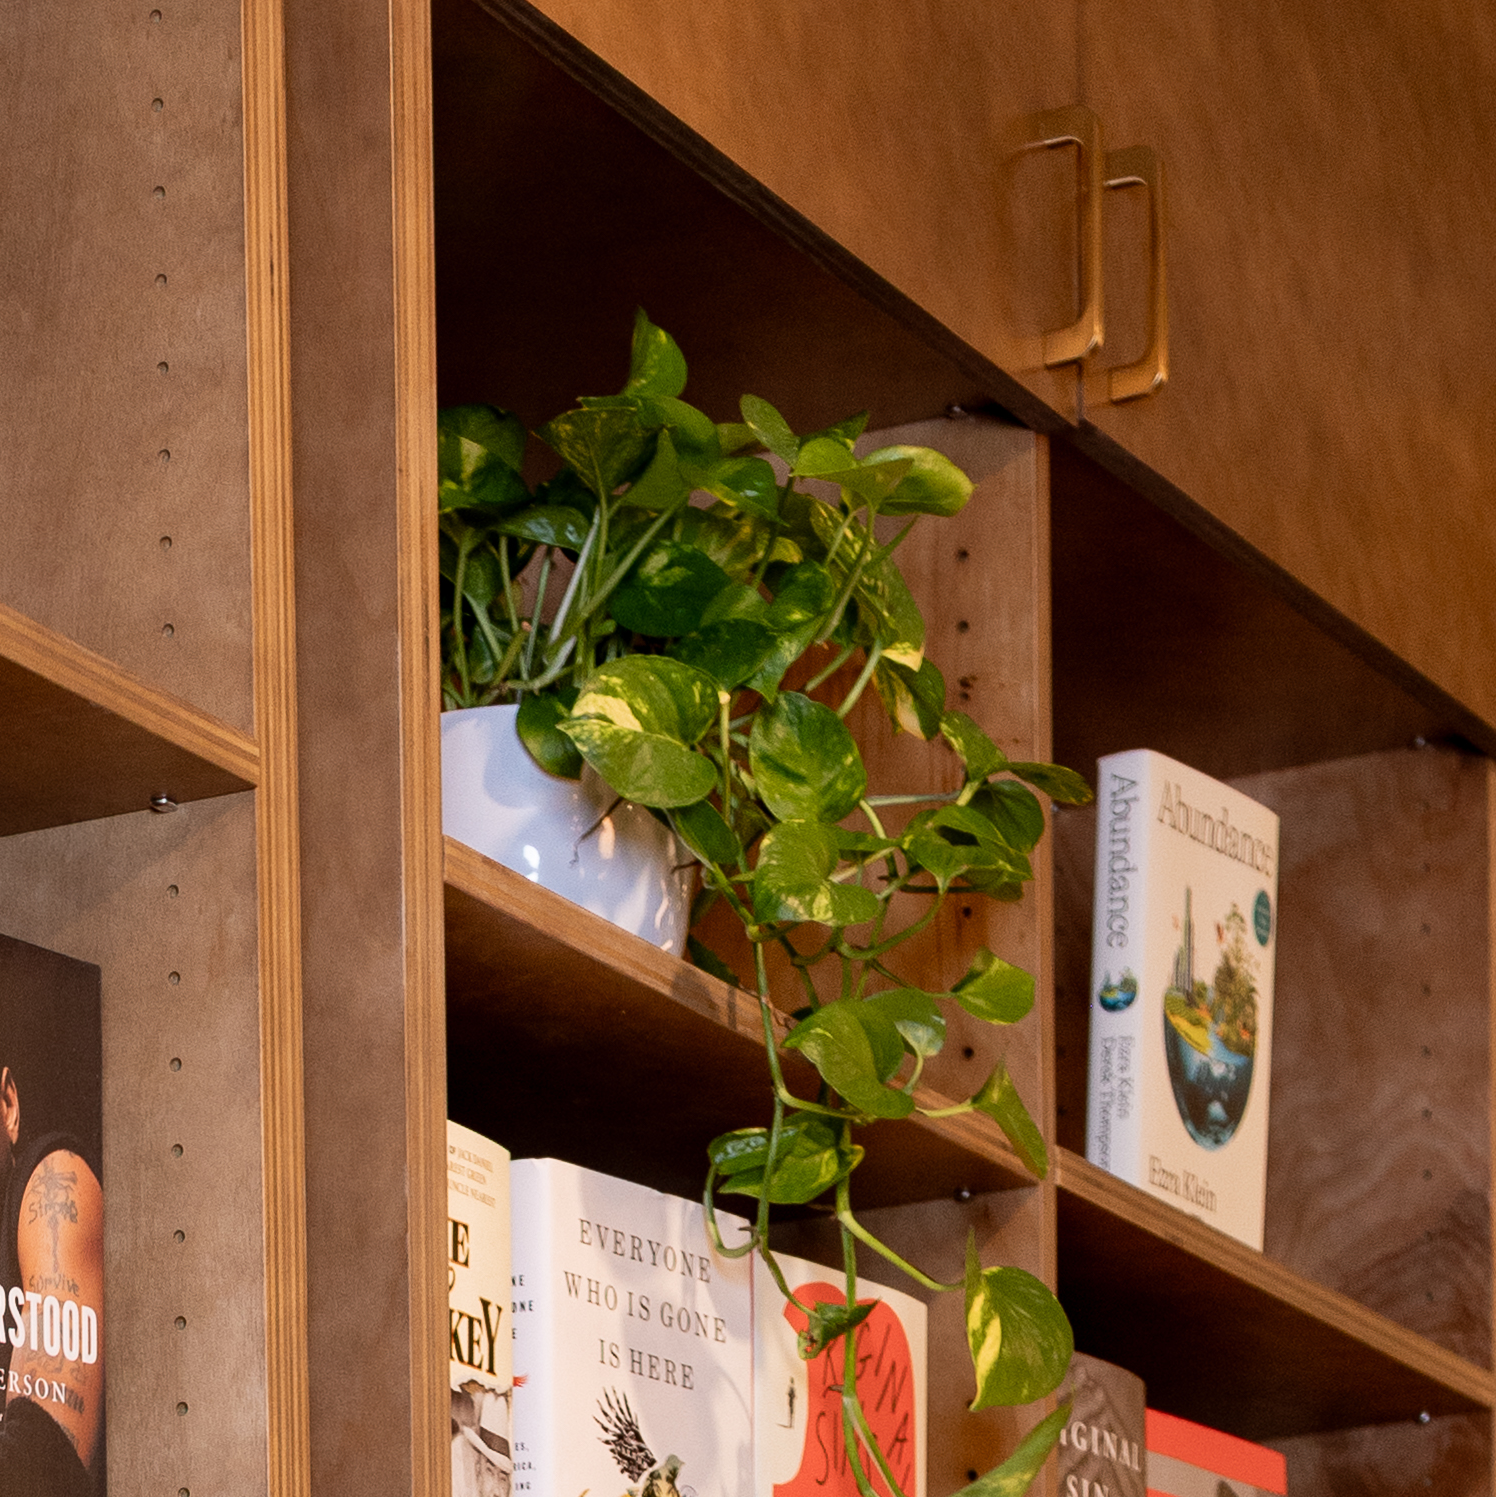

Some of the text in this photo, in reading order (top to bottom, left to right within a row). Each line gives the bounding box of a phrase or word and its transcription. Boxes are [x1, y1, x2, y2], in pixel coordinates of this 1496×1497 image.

[1157, 779, 1273, 878] Abundance
[577, 1217, 711, 1285] EVERYONE
[563, 1271, 729, 1345] WHO IS GONE
[598, 1338, 695, 1391] IS HERE
